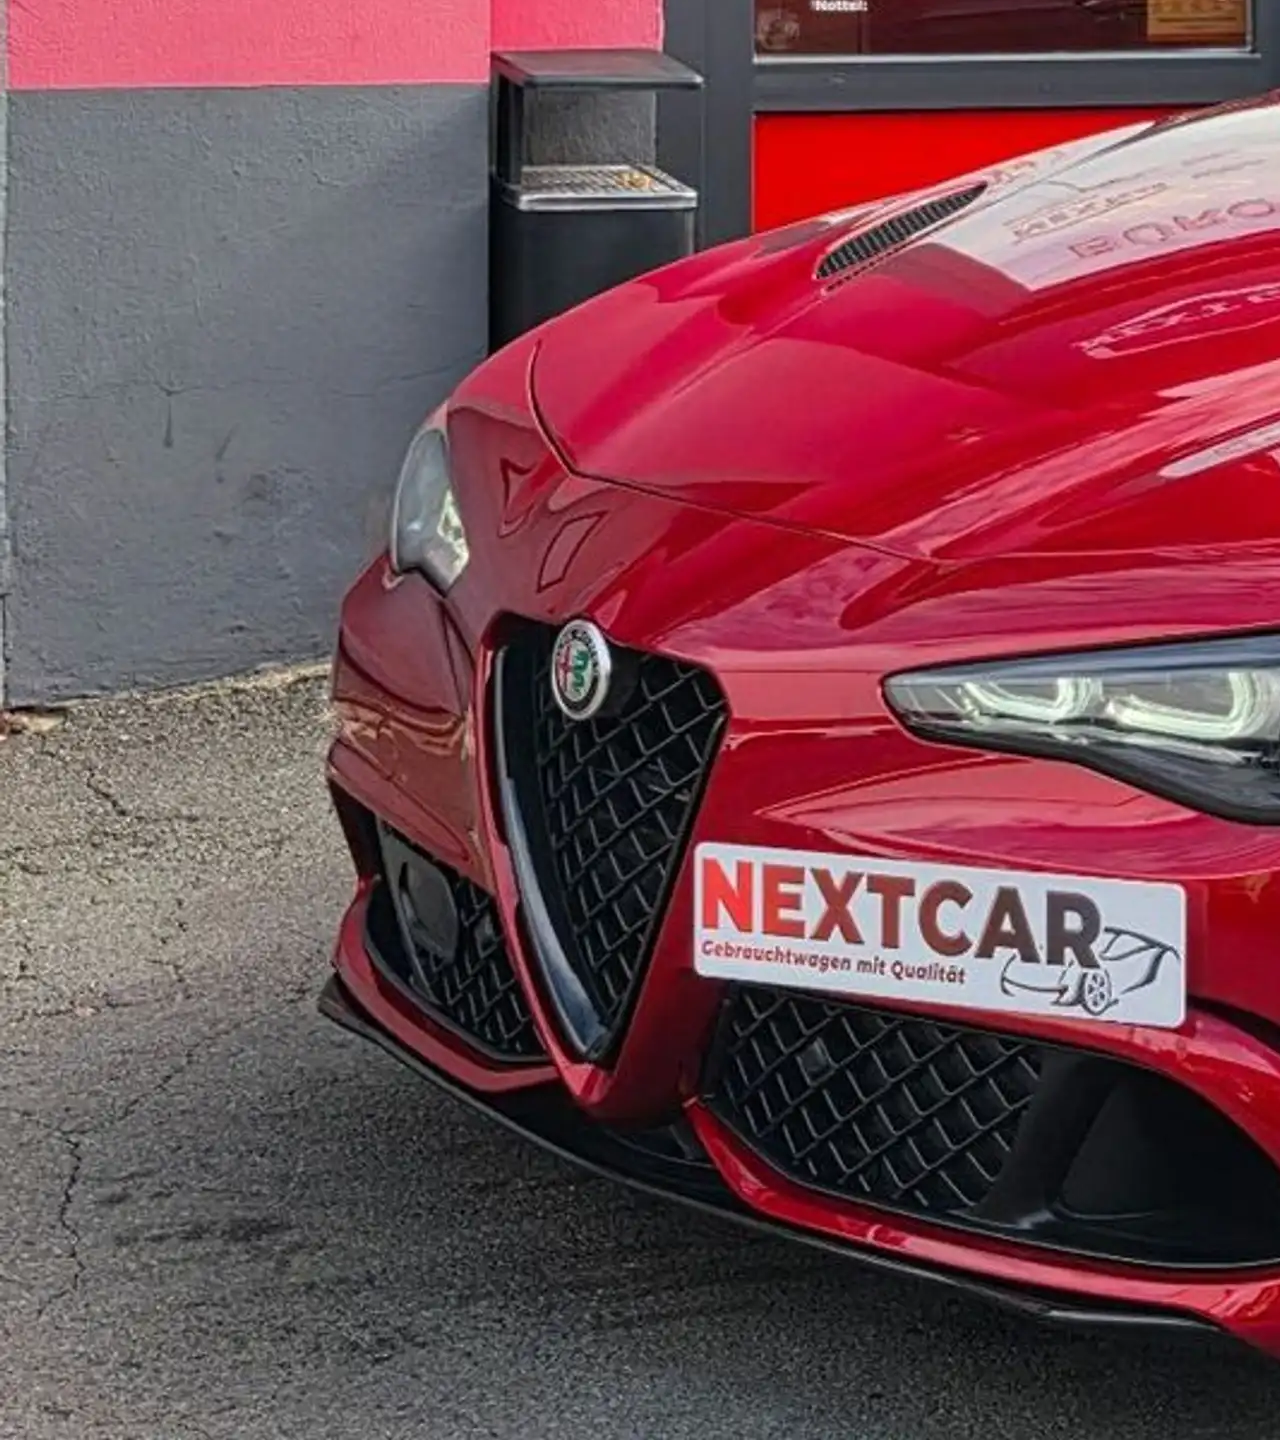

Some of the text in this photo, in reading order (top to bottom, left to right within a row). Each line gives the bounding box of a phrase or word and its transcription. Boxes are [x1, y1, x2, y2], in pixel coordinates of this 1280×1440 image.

[701, 856, 1103, 968] NEXTCAR
[701, 939, 967, 986] Gebrauchtwagen mit Qualität
